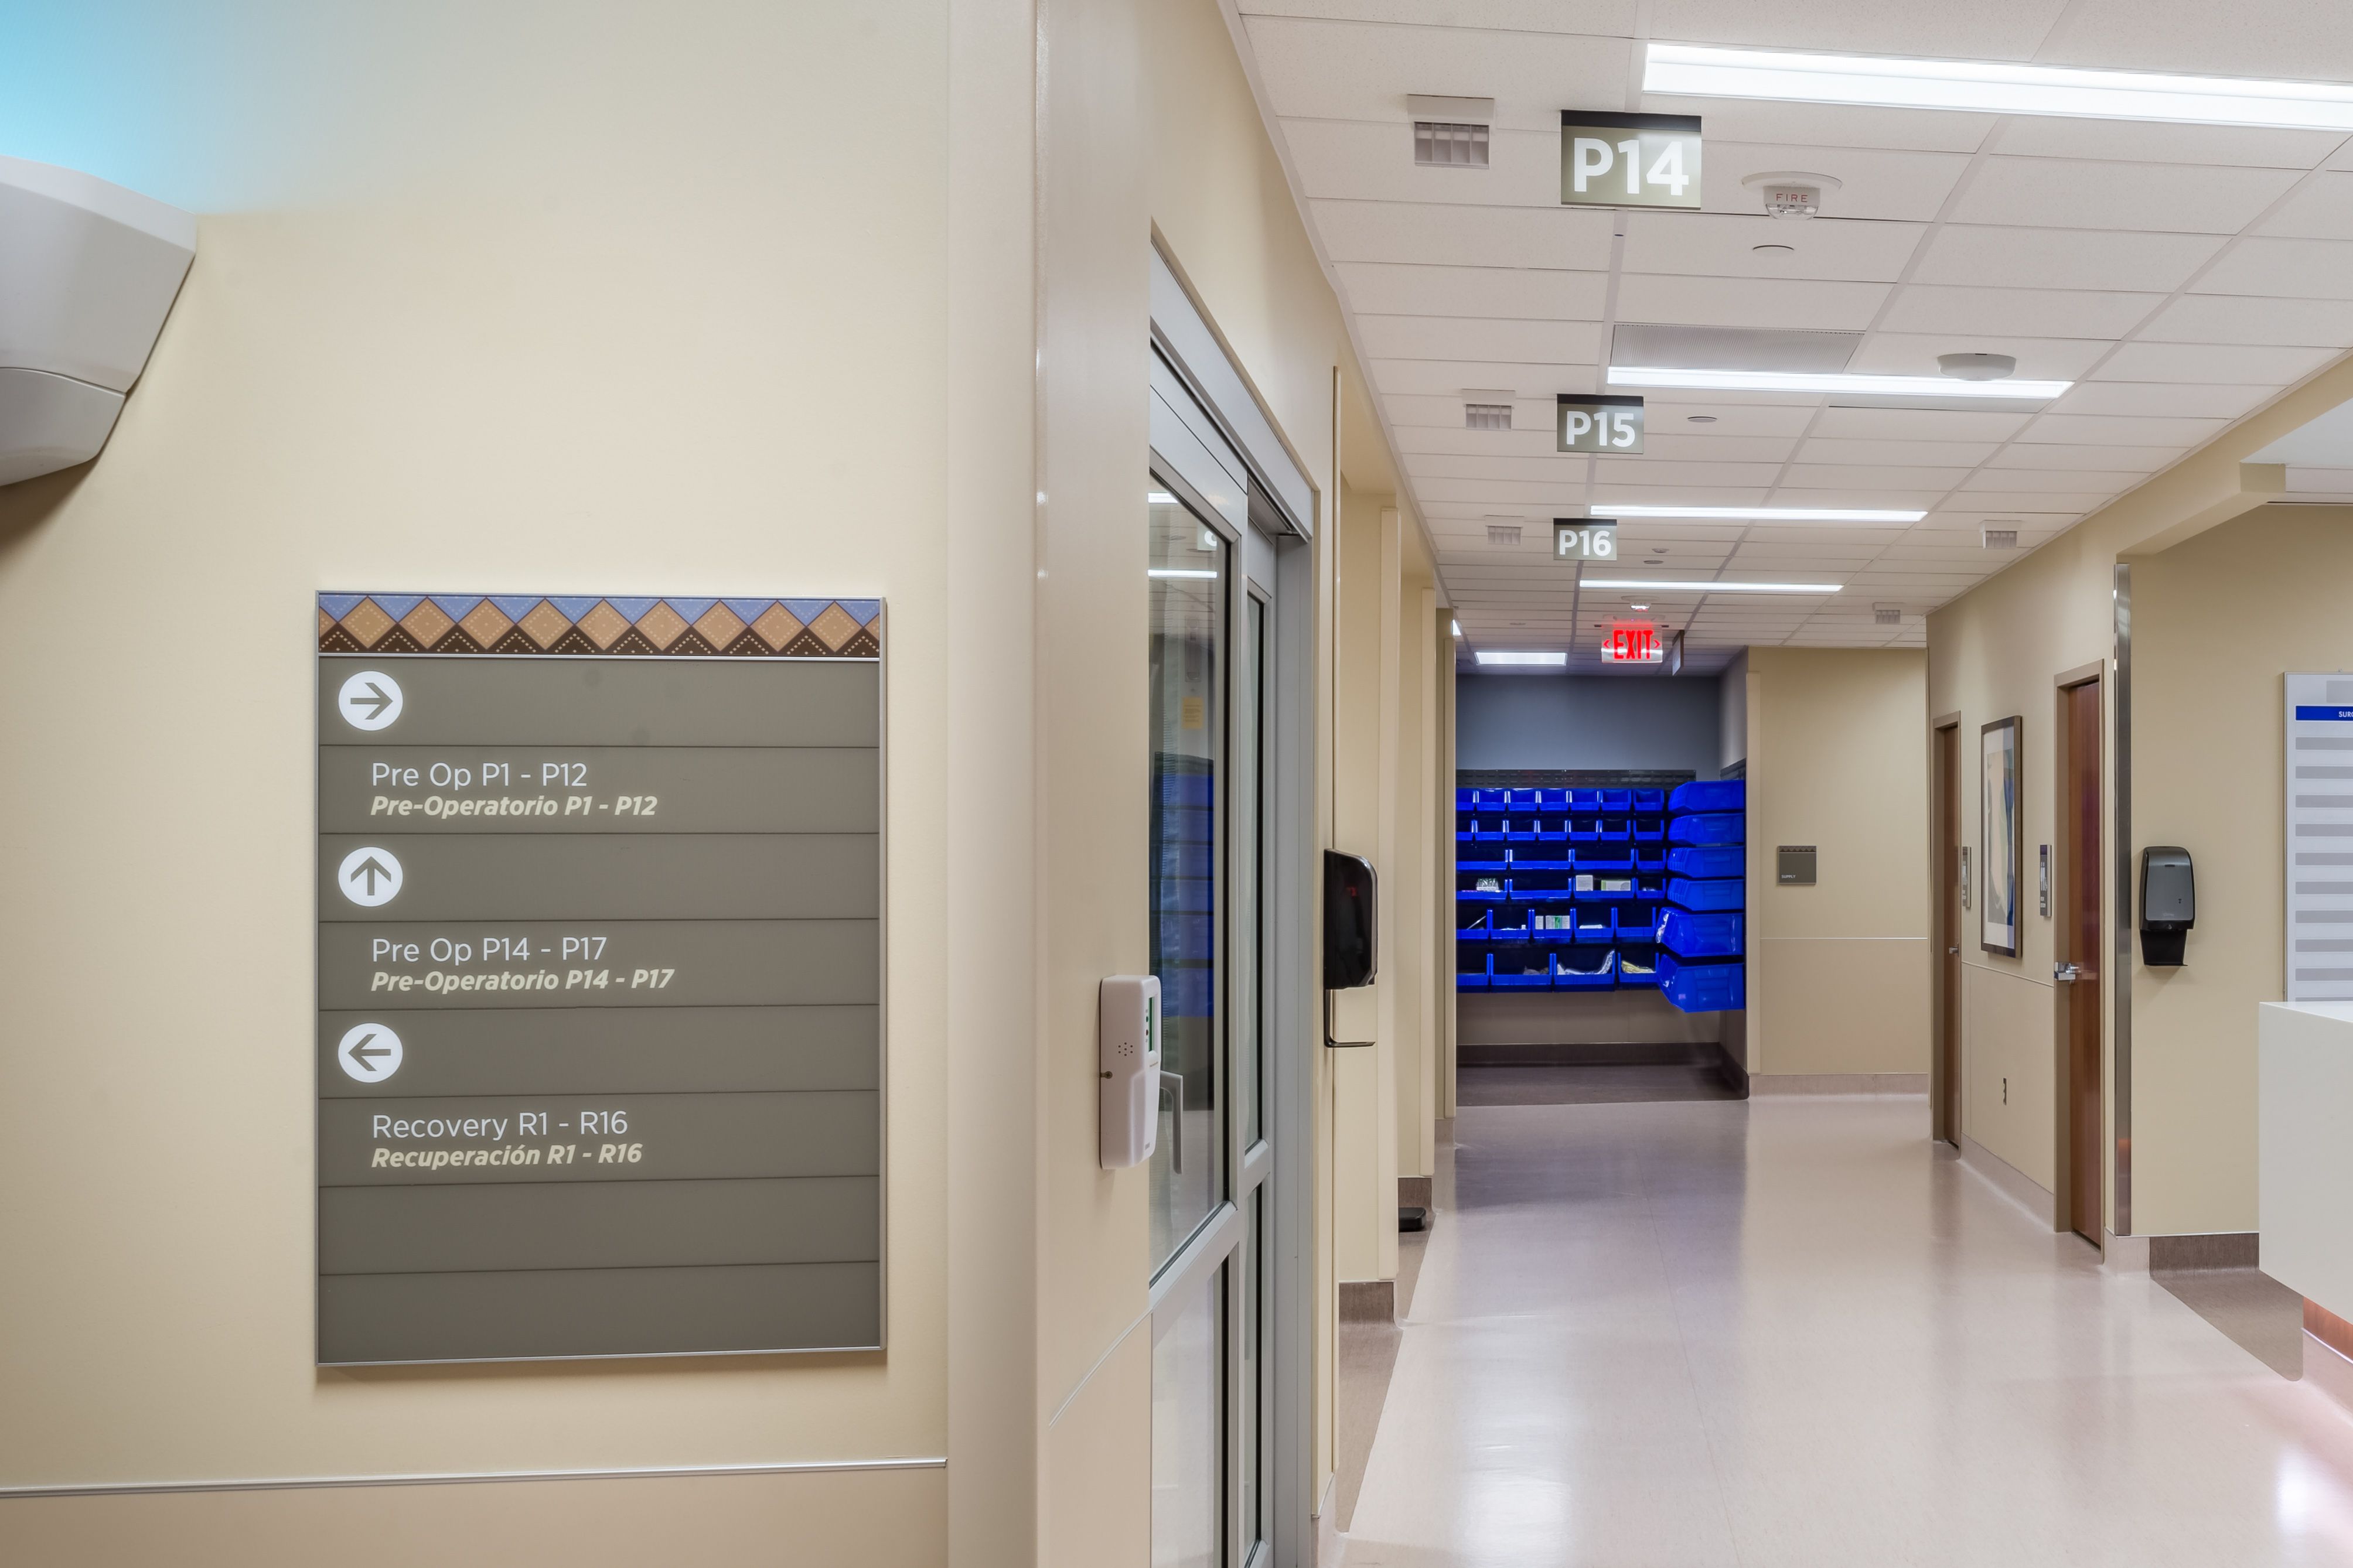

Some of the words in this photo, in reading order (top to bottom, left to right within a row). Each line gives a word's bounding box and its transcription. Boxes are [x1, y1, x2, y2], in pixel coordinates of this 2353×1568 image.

[1573, 136, 1690, 196] P14
[1776, 193, 1808, 203] FIRE
[1566, 411, 1635, 447] P15
[1559, 530, 1612, 556] P16
[1613, 629, 1653, 660] EXIT
[373, 763, 419, 787] Pre
[429, 762, 471, 791] Op
[482, 763, 509, 786] P1
[543, 763, 587, 787] P12
[370, 795, 558, 819] Pre-Operatorio
[564, 795, 593, 815] P1
[614, 795, 658, 815] P12
[373, 938, 420, 962] Pre
[430, 938, 472, 966] Op
[483, 937, 530, 961] P14
[562, 937, 607, 961] P17
[371, 970, 559, 995] Pre-Operatorio
[565, 969, 609, 989] P14
[631, 969, 675, 989] P17
[373, 1115, 508, 1141] Recovery
[519, 1112, 547, 1136] R1
[581, 1111, 628, 1135] R16
[371, 1144, 540, 1170] Recuperación
[547, 1145, 576, 1164] R1
[598, 1143, 643, 1163] R16
